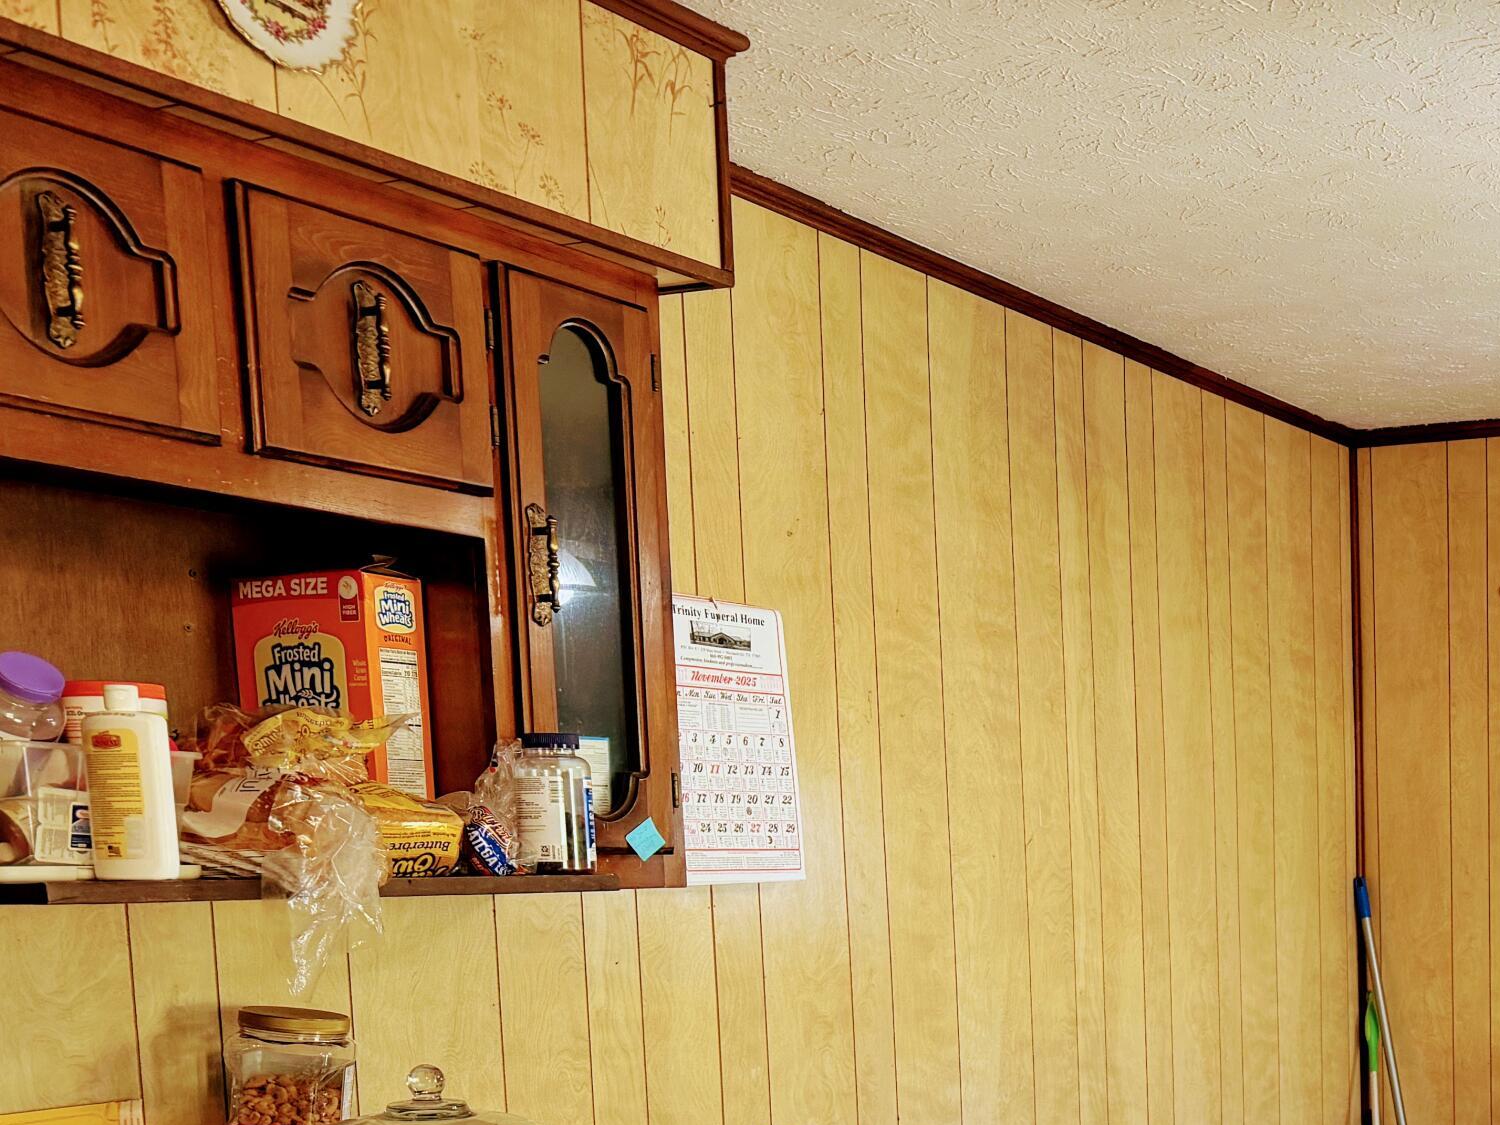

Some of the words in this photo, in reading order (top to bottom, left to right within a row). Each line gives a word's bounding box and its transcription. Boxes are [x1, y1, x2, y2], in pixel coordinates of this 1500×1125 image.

[239, 579, 286, 599] MEGA
[290, 577, 328, 596] SIZE
[383, 591, 405, 601] Frosted
[381, 600, 410, 614] Mini
[379, 612, 413, 627] Wheats
[673, 604, 702, 619] Trinity
[740, 613, 765, 626] Home
[273, 617, 319, 640] Kellogg's
[383, 635, 412, 645] ORIGINAL
[274, 644, 319, 663] Frosted
[267, 661, 332, 699] Mini
[691, 671, 733, 685] November
[735, 676, 758, 687] 2025
[775, 708, 781, 719] 1
[691, 733, 698, 743] 3
[709, 734, 716, 744] 4
[726, 734, 733, 745] 5
[742, 736, 749, 746] 6
[759, 737, 766, 747] 7
[778, 737, 785, 748] 8
[692, 763, 704, 773] 10
[710, 764, 721, 774] 11
[727, 764, 738, 775] 12
[743, 765, 754, 776] 13
[761, 765, 772, 776] 14
[780, 766, 790, 777] 15
[696, 793, 707, 804] 17
[714, 793, 724, 804] 18
[730, 793, 741, 804] 19
[747, 794, 758, 805] 20
[764, 794, 775, 805] 21
[781, 795, 793, 805] 22
[700, 822, 712, 833] 24
[717, 823, 727, 833] 25
[733, 823, 744, 833] 26
[750, 823, 761, 834] 27
[767, 823, 779, 834] 28
[785, 823, 796, 834] 29
[387, 841, 451, 853] Butterbre
